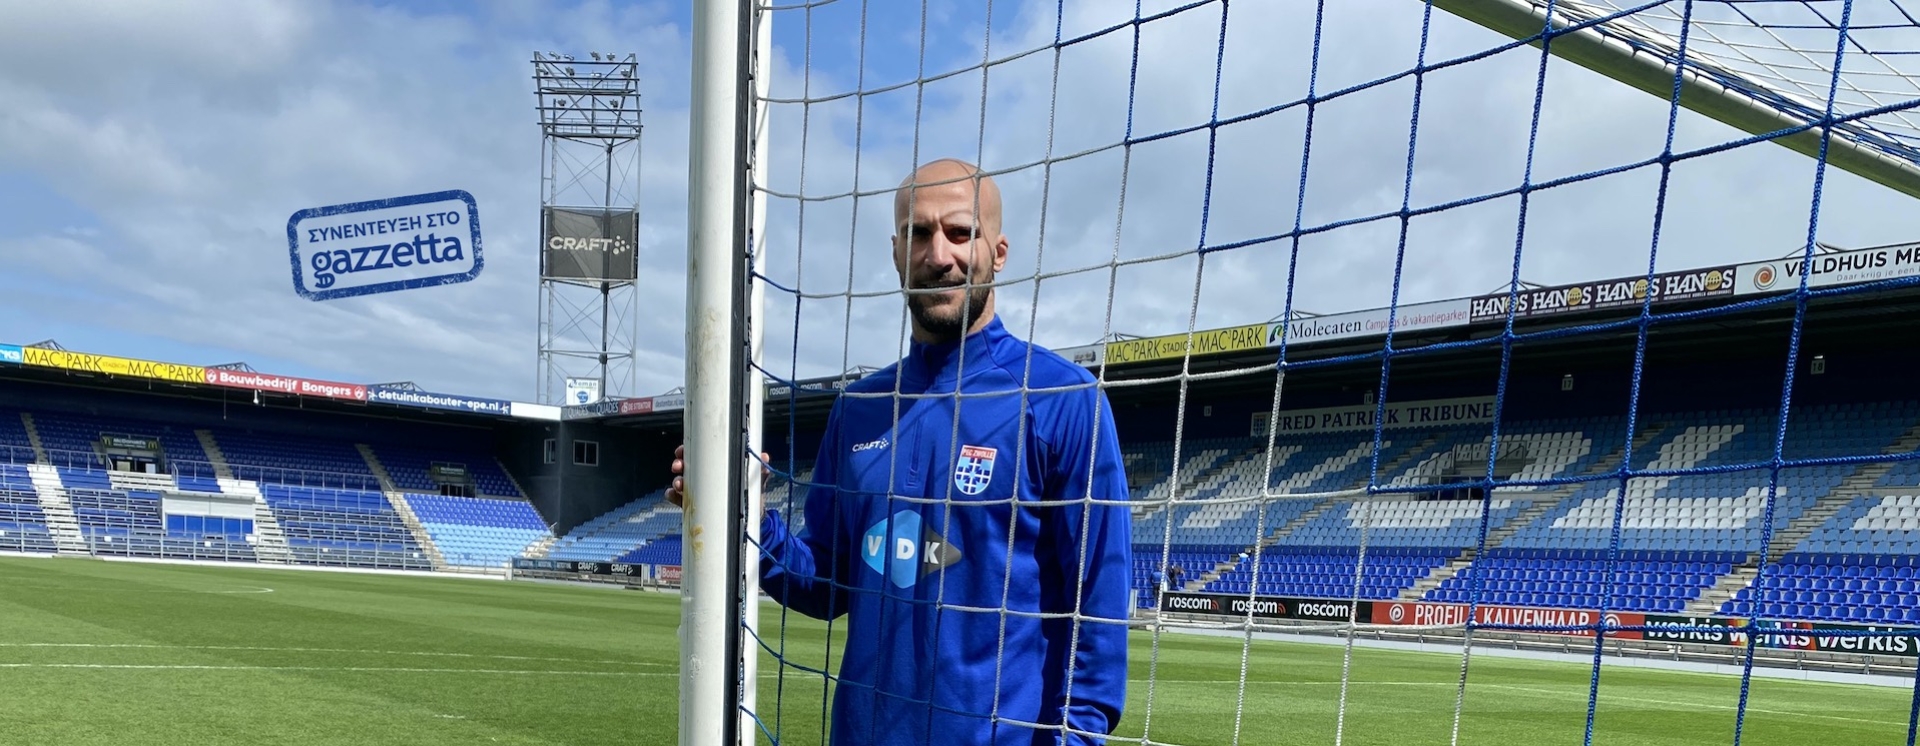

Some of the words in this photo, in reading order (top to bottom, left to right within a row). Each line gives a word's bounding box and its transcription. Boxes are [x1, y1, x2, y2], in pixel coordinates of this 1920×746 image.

[549, 236, 613, 251] CRAFT
[1664, 269, 1733, 295] HANOS
[1837, 273, 1857, 281] Daar
[1861, 271, 1882, 279] krijg
[1885, 269, 1893, 277] je
[1898, 267, 1914, 275] een
[1531, 286, 1592, 311] HANOS
[1410, 309, 1467, 326] vakantieparken
[1290, 319, 1361, 340] Molecaten
[220, 371, 297, 392] Bouwbedrijf
[302, 382, 351, 396] Bongers
[378, 390, 499, 411] detuinkabouter-epe.nl
[1407, 402, 1493, 423] TRIBUNE
[852, 440, 880, 452] CRAFT
[578, 562, 594, 571] CRAFT
[611, 563, 629, 573] CRAFT
[1169, 596, 1212, 610] roscom
[1232, 599, 1278, 614] roscom
[1298, 602, 1349, 617] roscom
[1646, 617, 1723, 641] werkis
